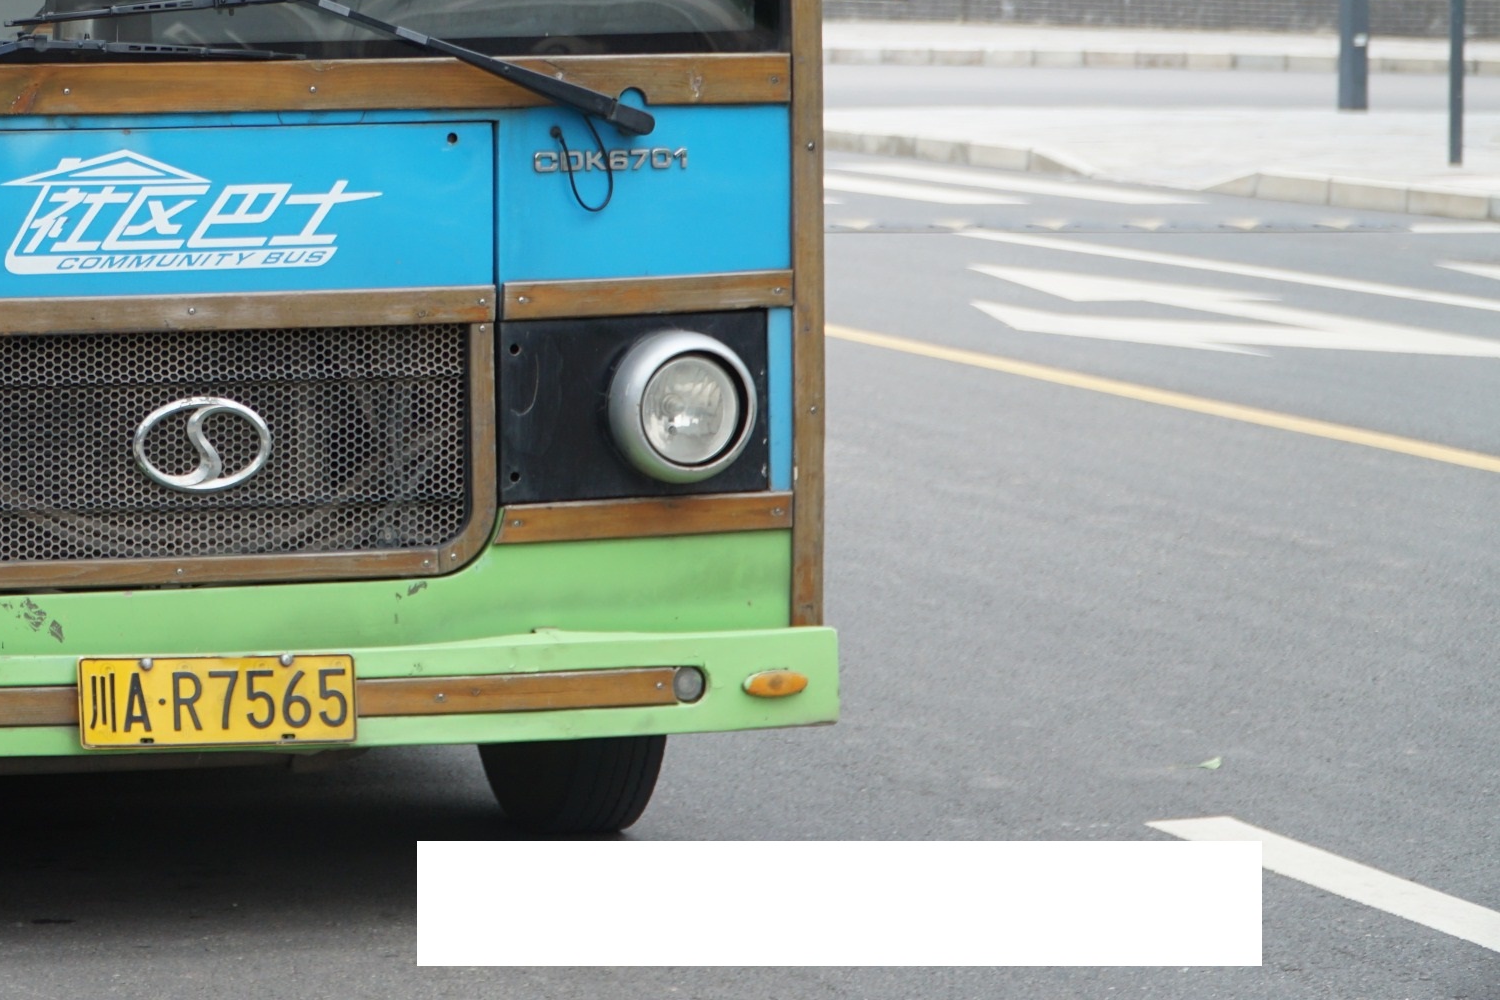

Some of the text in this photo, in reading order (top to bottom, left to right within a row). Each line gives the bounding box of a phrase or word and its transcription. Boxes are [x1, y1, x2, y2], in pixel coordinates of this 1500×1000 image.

[534, 148, 689, 173] CDK6701
[23, 180, 383, 253] 社区巴士
[56, 250, 327, 271] COMMUNITY BUS
[89, 668, 347, 733] 川A·R7565
